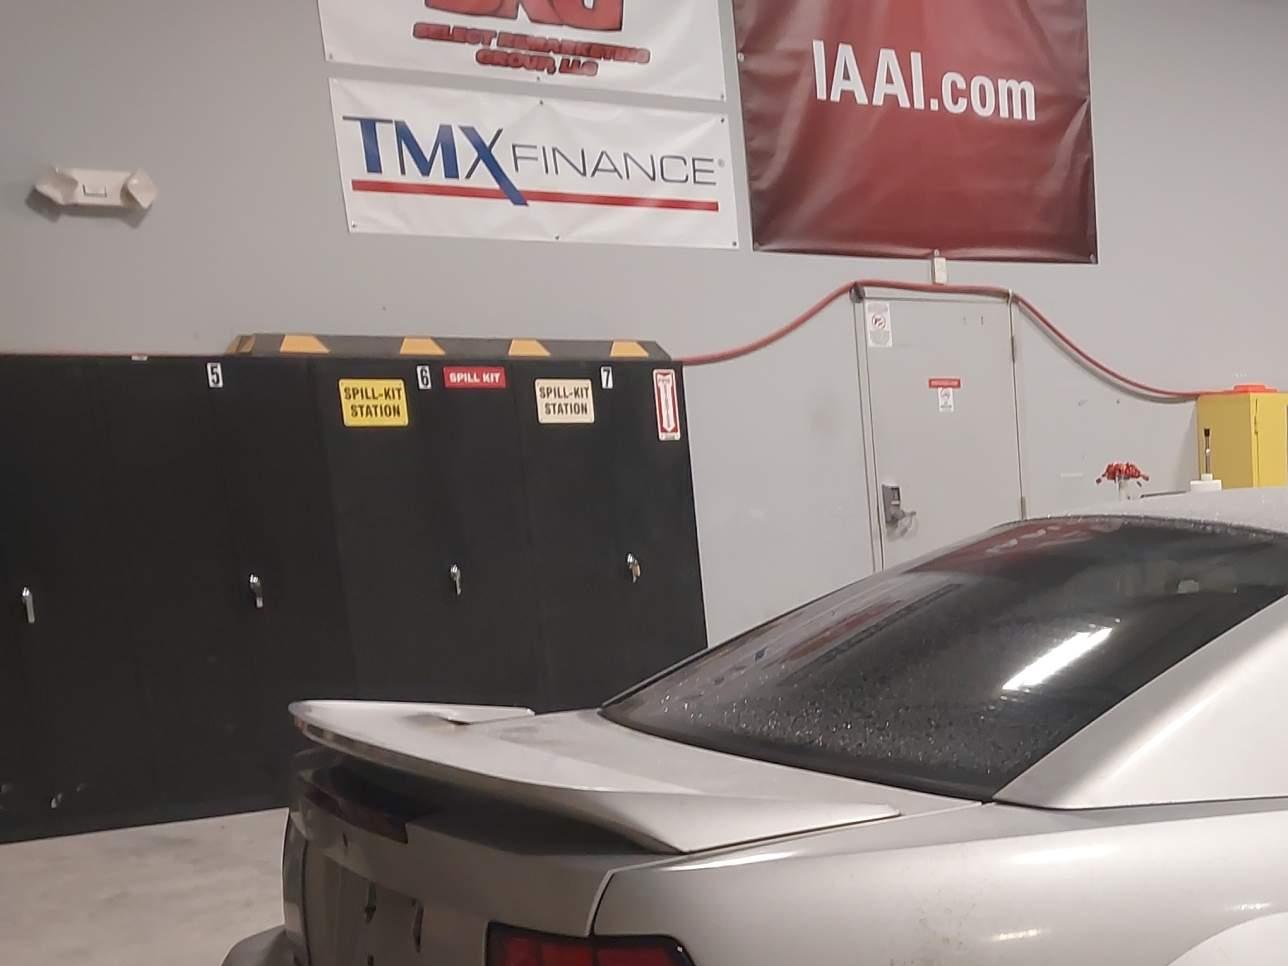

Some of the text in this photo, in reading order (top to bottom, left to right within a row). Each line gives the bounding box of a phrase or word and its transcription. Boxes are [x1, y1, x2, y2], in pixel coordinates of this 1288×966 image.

[413, 22, 497, 46] SELECT
[812, 39, 1036, 121] IAAI.com
[342, 115, 717, 206] TMX FINANCE
[210, 364, 221, 386] 5
[419, 367, 429, 387] 6
[449, 373, 501, 383] SPILL KIT
[603, 368, 611, 387] 7
[344, 387, 402, 401] SPILL-KIT
[539, 386, 590, 399] SPILL-KIT
[351, 404, 401, 418] STATION
[545, 402, 588, 415] STATION
